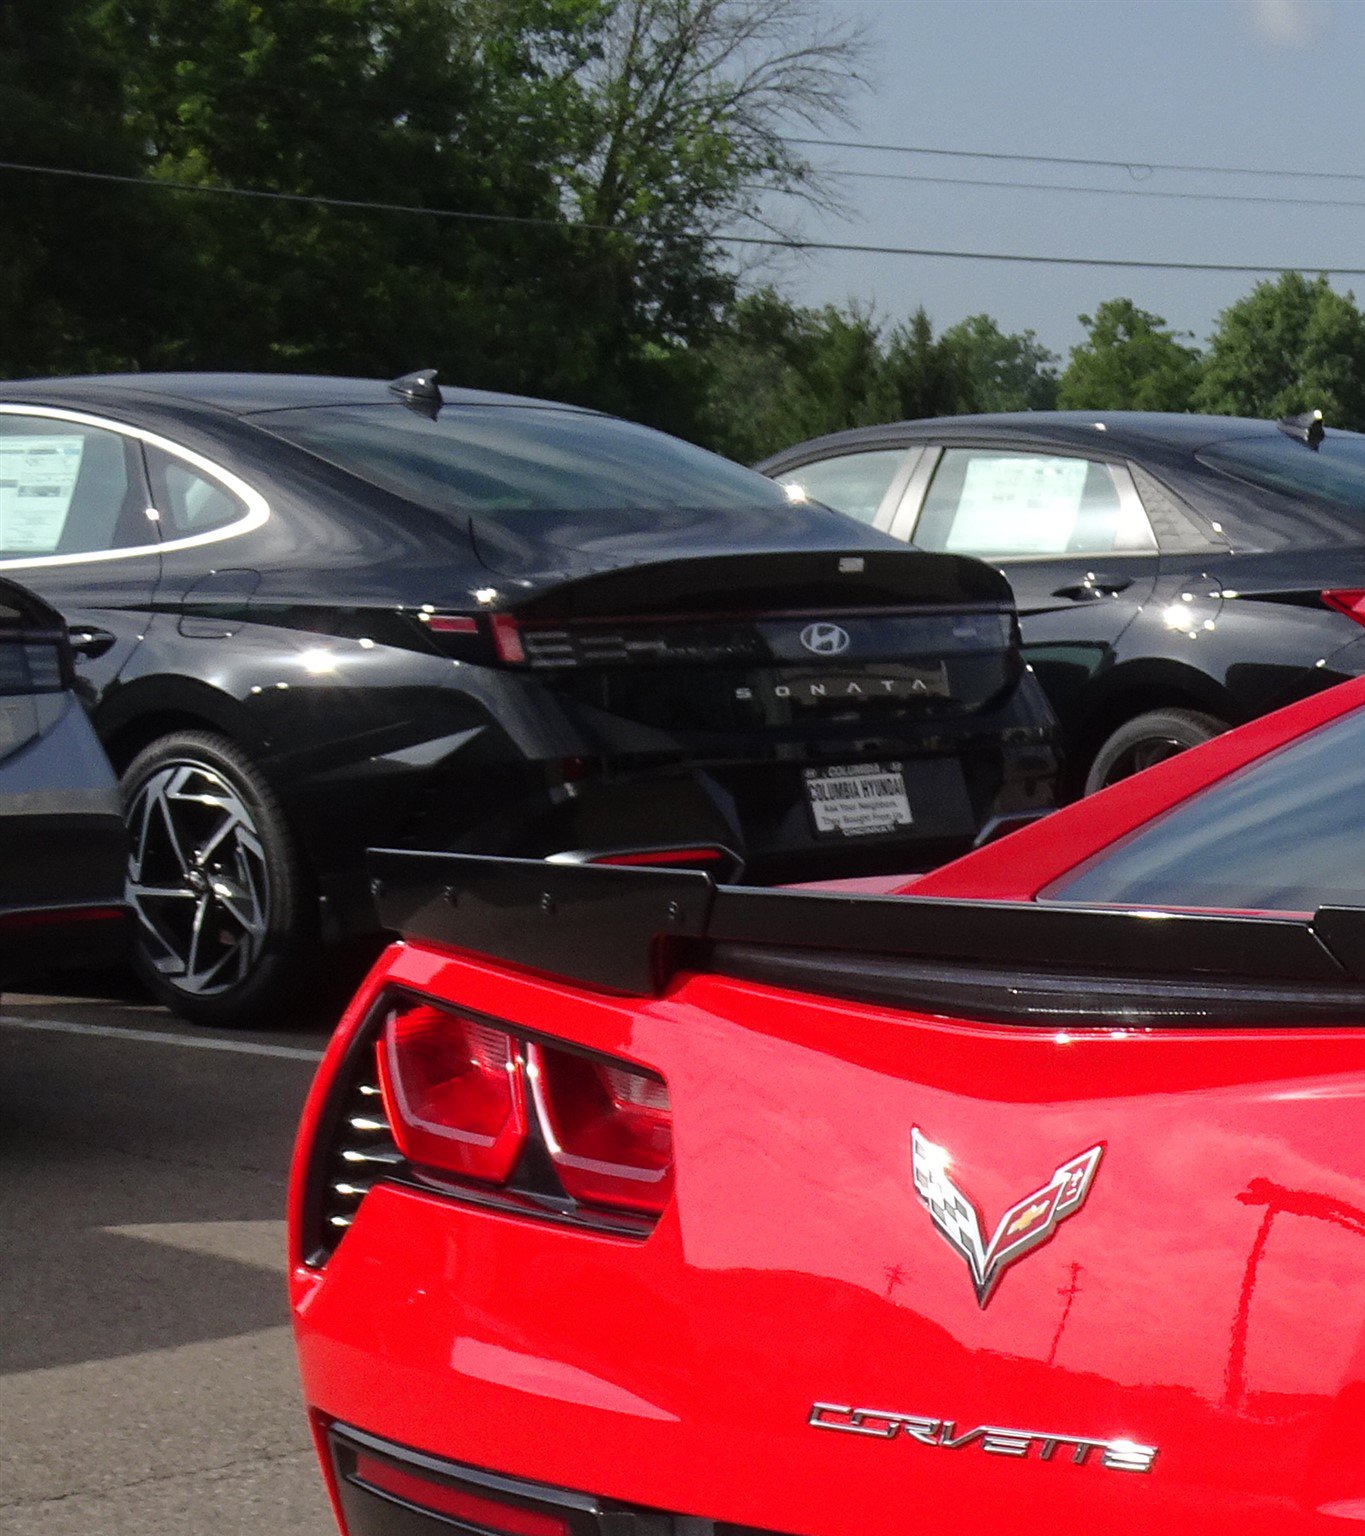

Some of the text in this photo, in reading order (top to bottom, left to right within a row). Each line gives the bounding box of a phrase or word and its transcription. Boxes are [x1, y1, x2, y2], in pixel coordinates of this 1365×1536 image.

[734, 678, 928, 700] SONATA
[808, 778, 905, 802] COLUMBIA HYUNDAI
[808, 1402, 1160, 1473] CORVETTE
